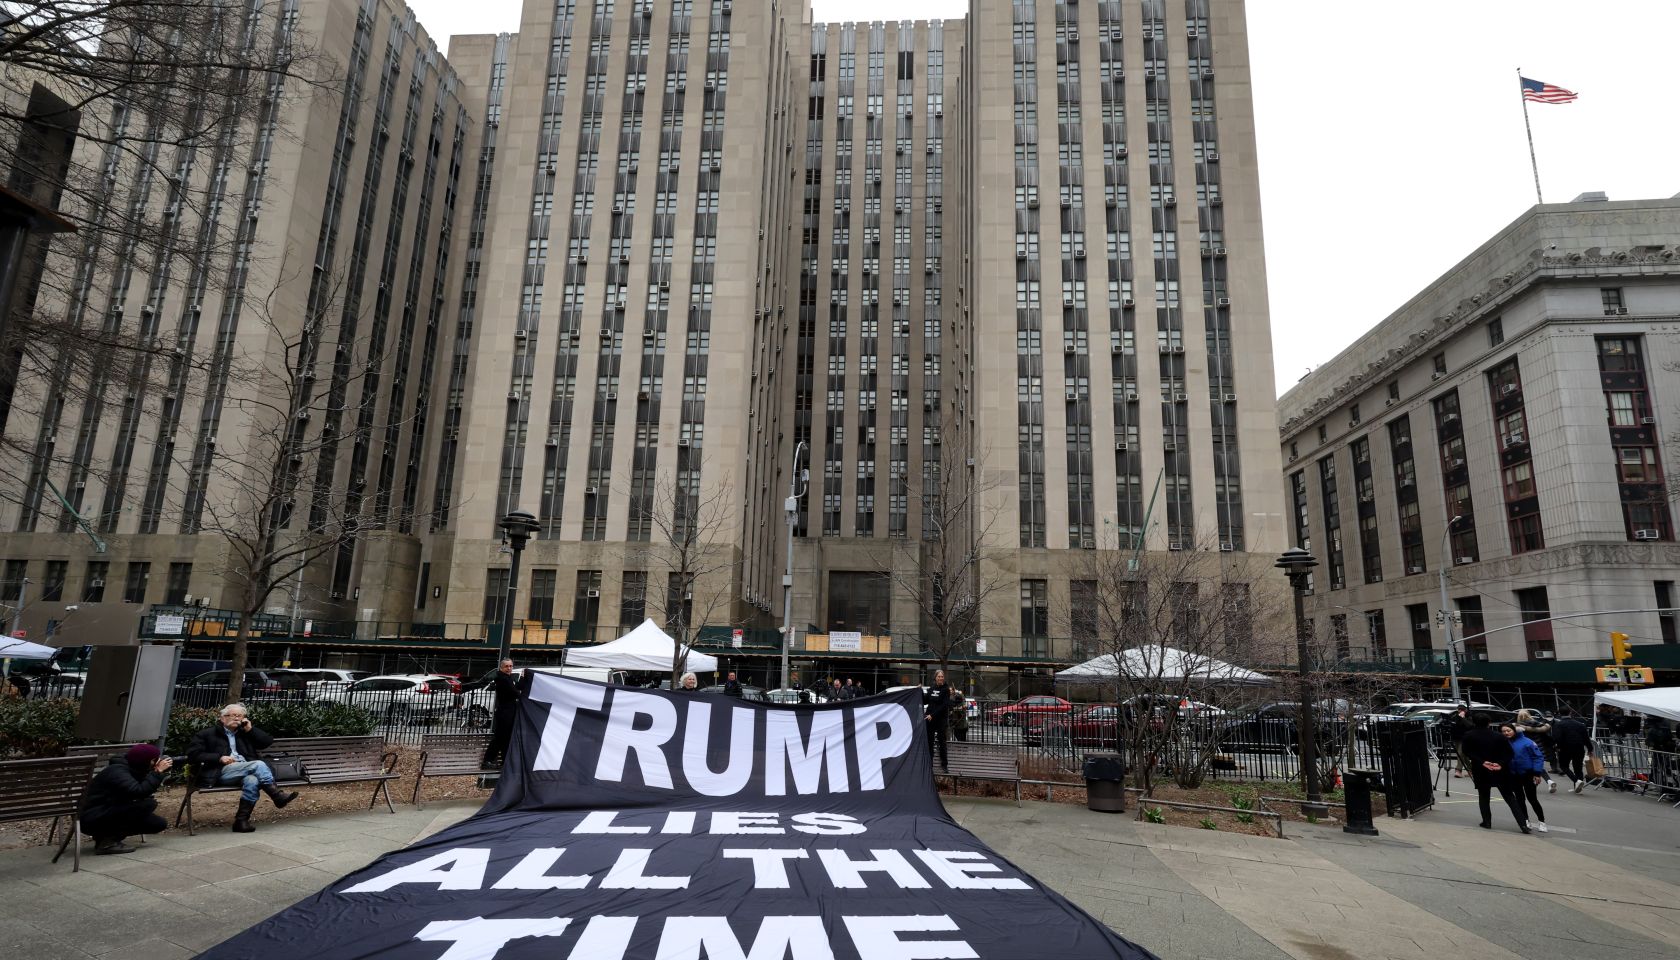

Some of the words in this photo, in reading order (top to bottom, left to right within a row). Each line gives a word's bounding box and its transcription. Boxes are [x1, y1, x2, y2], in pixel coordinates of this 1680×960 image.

[528, 672, 914, 797] TRUMP
[570, 811, 868, 836] LIES
[339, 847, 691, 894] ALL
[723, 847, 1034, 890] THE
[414, 914, 982, 960] TIME
